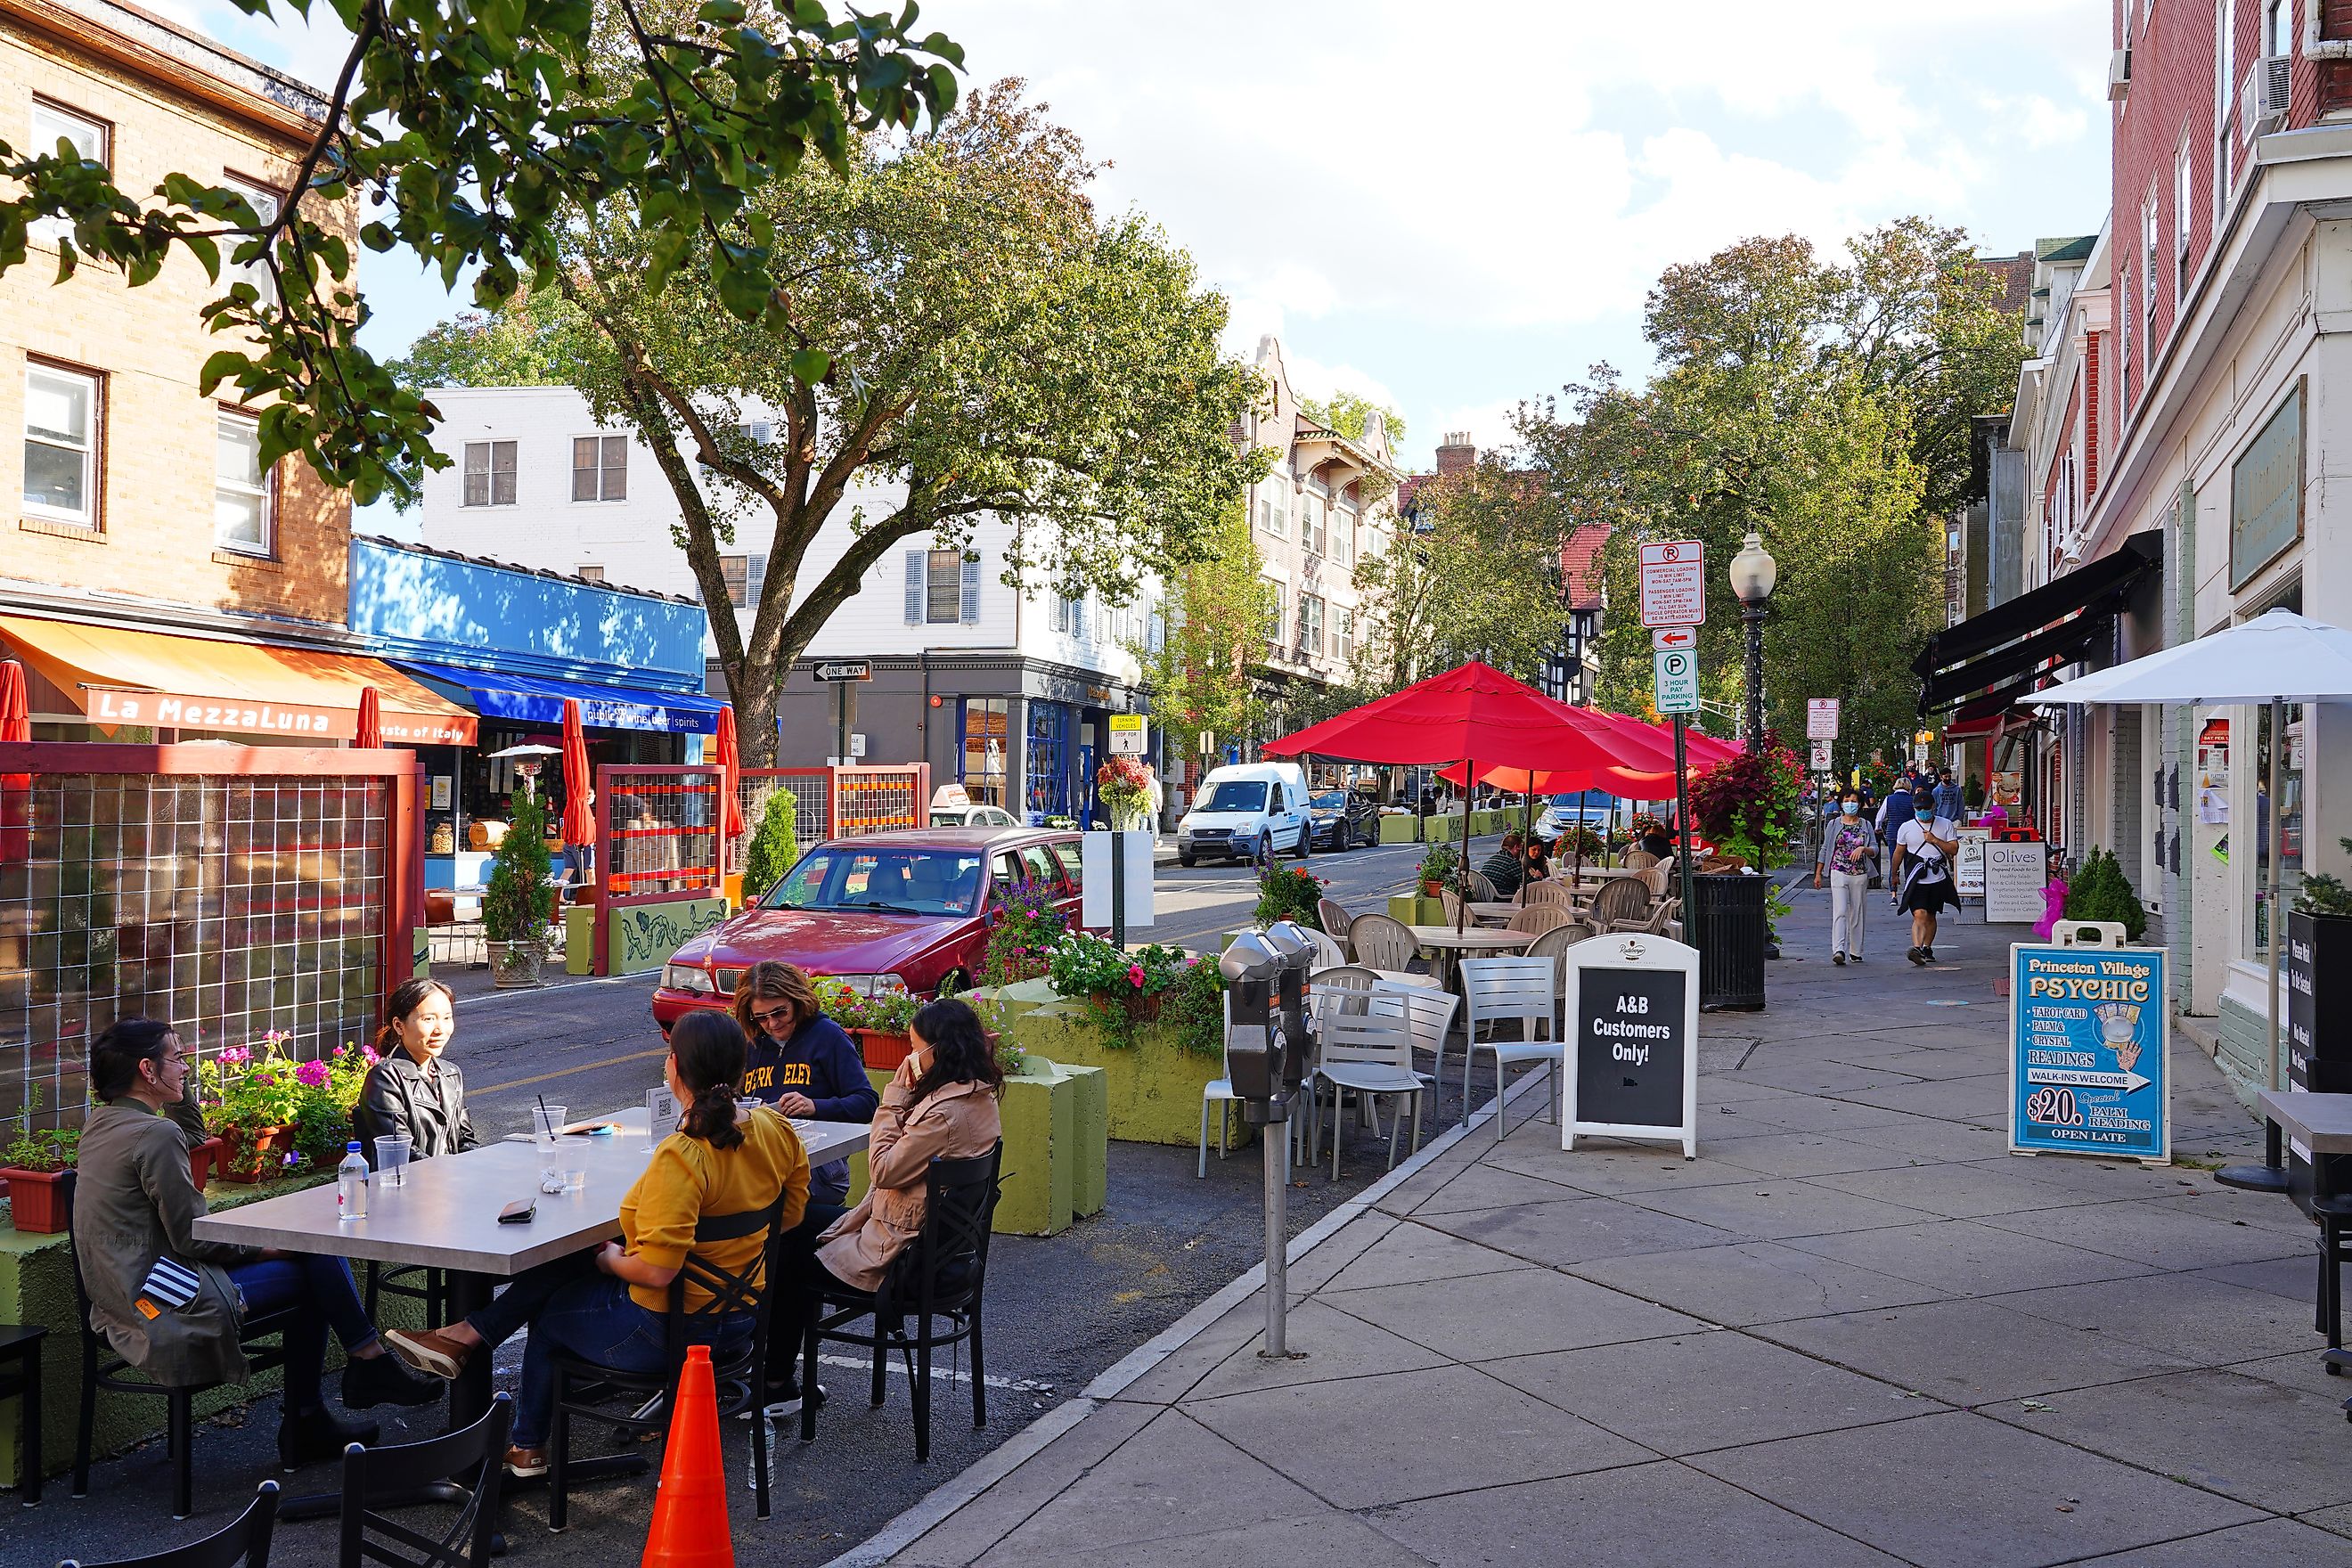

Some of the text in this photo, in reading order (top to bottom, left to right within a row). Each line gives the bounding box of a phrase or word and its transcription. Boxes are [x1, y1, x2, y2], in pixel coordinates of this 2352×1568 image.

[826, 666, 864, 675] ONE WAY
[1670, 658, 1681, 672] P
[100, 693, 330, 732] La MezzaLuna
[587, 709, 699, 729] public wine beer spirits
[413, 726, 429, 738] of
[433, 727, 464, 743] Italy
[1993, 849, 2037, 862] Olives
[2292, 939, 2310, 964] Please Wait
[2029, 959, 2151, 979] Princeton Village
[2291, 968, 2295, 987] To
[2296, 971, 2299, 990] Be
[2029, 976, 2149, 1002] PSYCHIC
[1616, 995, 1648, 1014] A&B
[2032, 1007, 2088, 1019] TAROT CARD
[1593, 1017, 1670, 1039] Customers
[2032, 1021, 2065, 1033] PALM &
[2293, 1023, 2299, 1041] No
[2032, 1035, 2070, 1047] CRYSTAL
[1613, 1042, 1649, 1066] Only!
[2028, 1049, 2095, 1067] READINGS
[2292, 1049, 2297, 1066] No
[783, 1063, 812, 1085] ELEY
[2031, 1072, 2127, 1085] WALK-INS WELCOME
[2027, 1086, 2083, 1126] $20.
[2078, 1090, 2120, 1107] Special
[2090, 1107, 2127, 1118] PALM
[2088, 1117, 2151, 1131] READING
[2051, 1128, 2126, 1142] OPEN LATE
